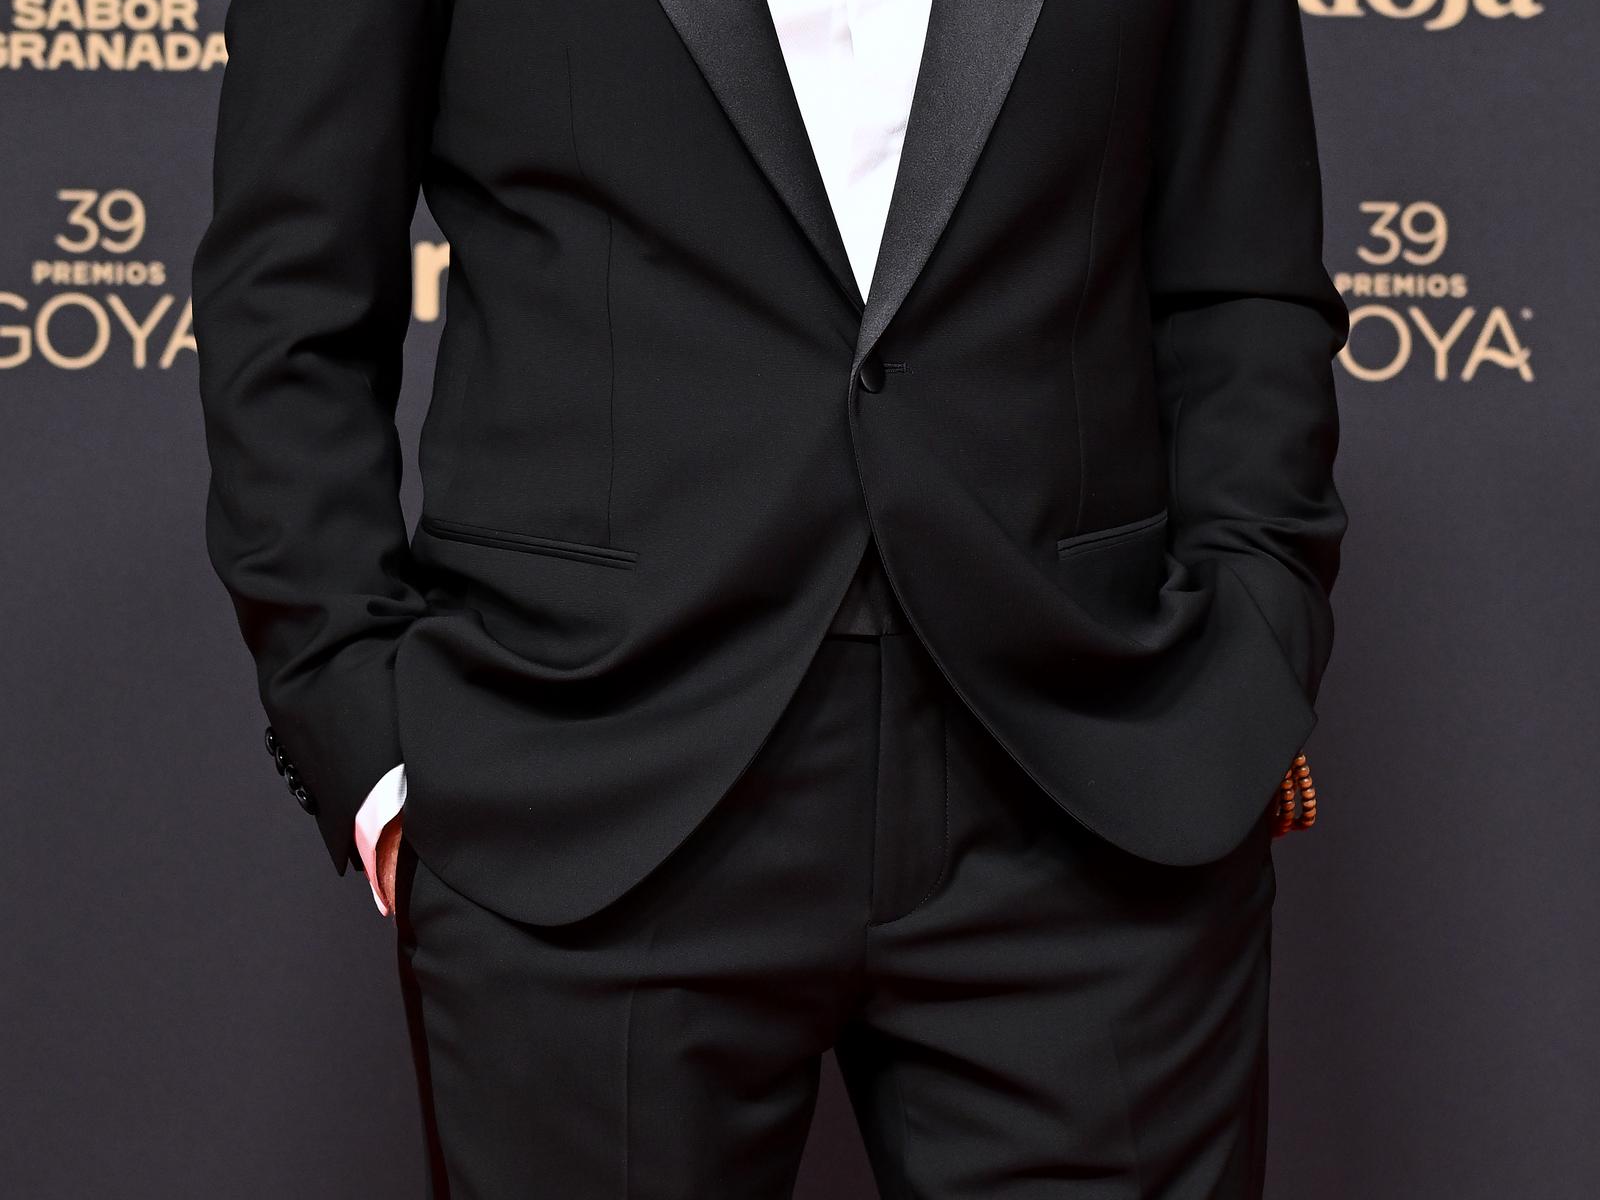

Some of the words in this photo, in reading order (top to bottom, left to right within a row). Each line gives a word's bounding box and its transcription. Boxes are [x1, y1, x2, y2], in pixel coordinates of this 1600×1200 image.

[0, 31, 229, 71] RANADA
[56, 190, 146, 253] 39
[1357, 202, 1449, 266] 39
[33, 261, 166, 285] PREMIOS
[1334, 273, 1468, 298] PREMIOS
[1338, 304, 1535, 383] OYA
